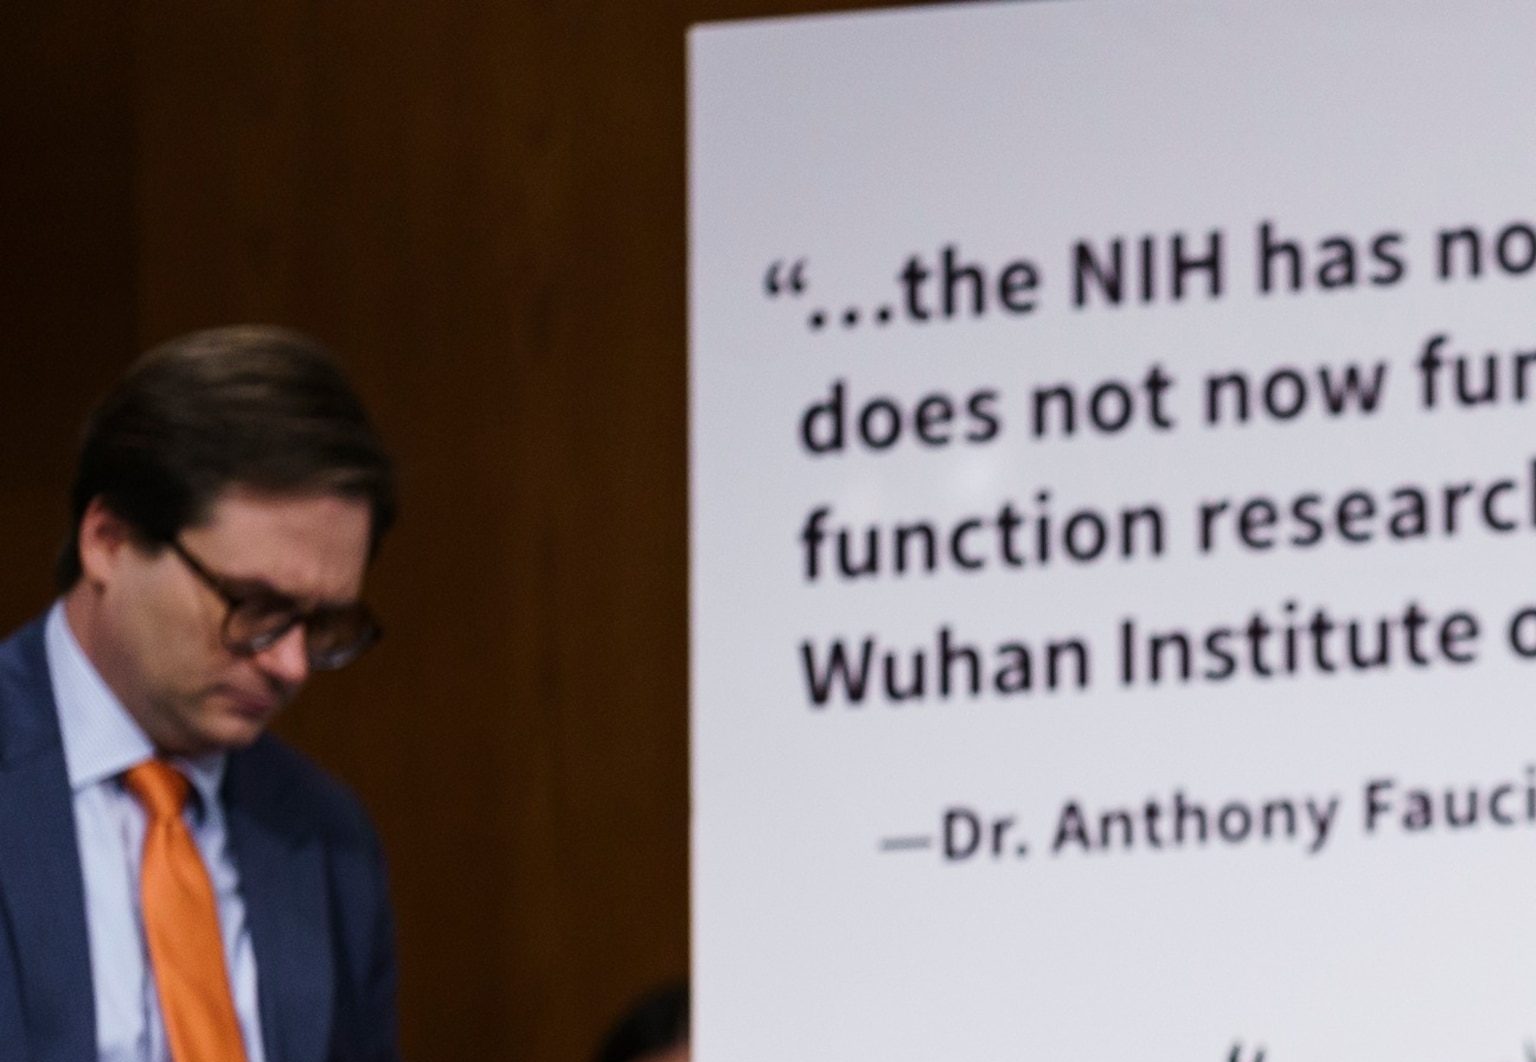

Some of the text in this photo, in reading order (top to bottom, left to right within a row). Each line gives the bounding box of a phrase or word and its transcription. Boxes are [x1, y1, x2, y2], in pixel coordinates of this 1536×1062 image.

[1070, 230, 1225, 310] NIH
[1257, 219, 1406, 291] has
[798, 379, 1002, 458] does
[1031, 363, 1176, 440] not
[1203, 360, 1388, 427] now
[799, 487, 1168, 583] function
[799, 623, 1090, 709] Wuhan
[1119, 601, 1480, 687] Institute
[1053, 780, 1341, 858] Anthony
